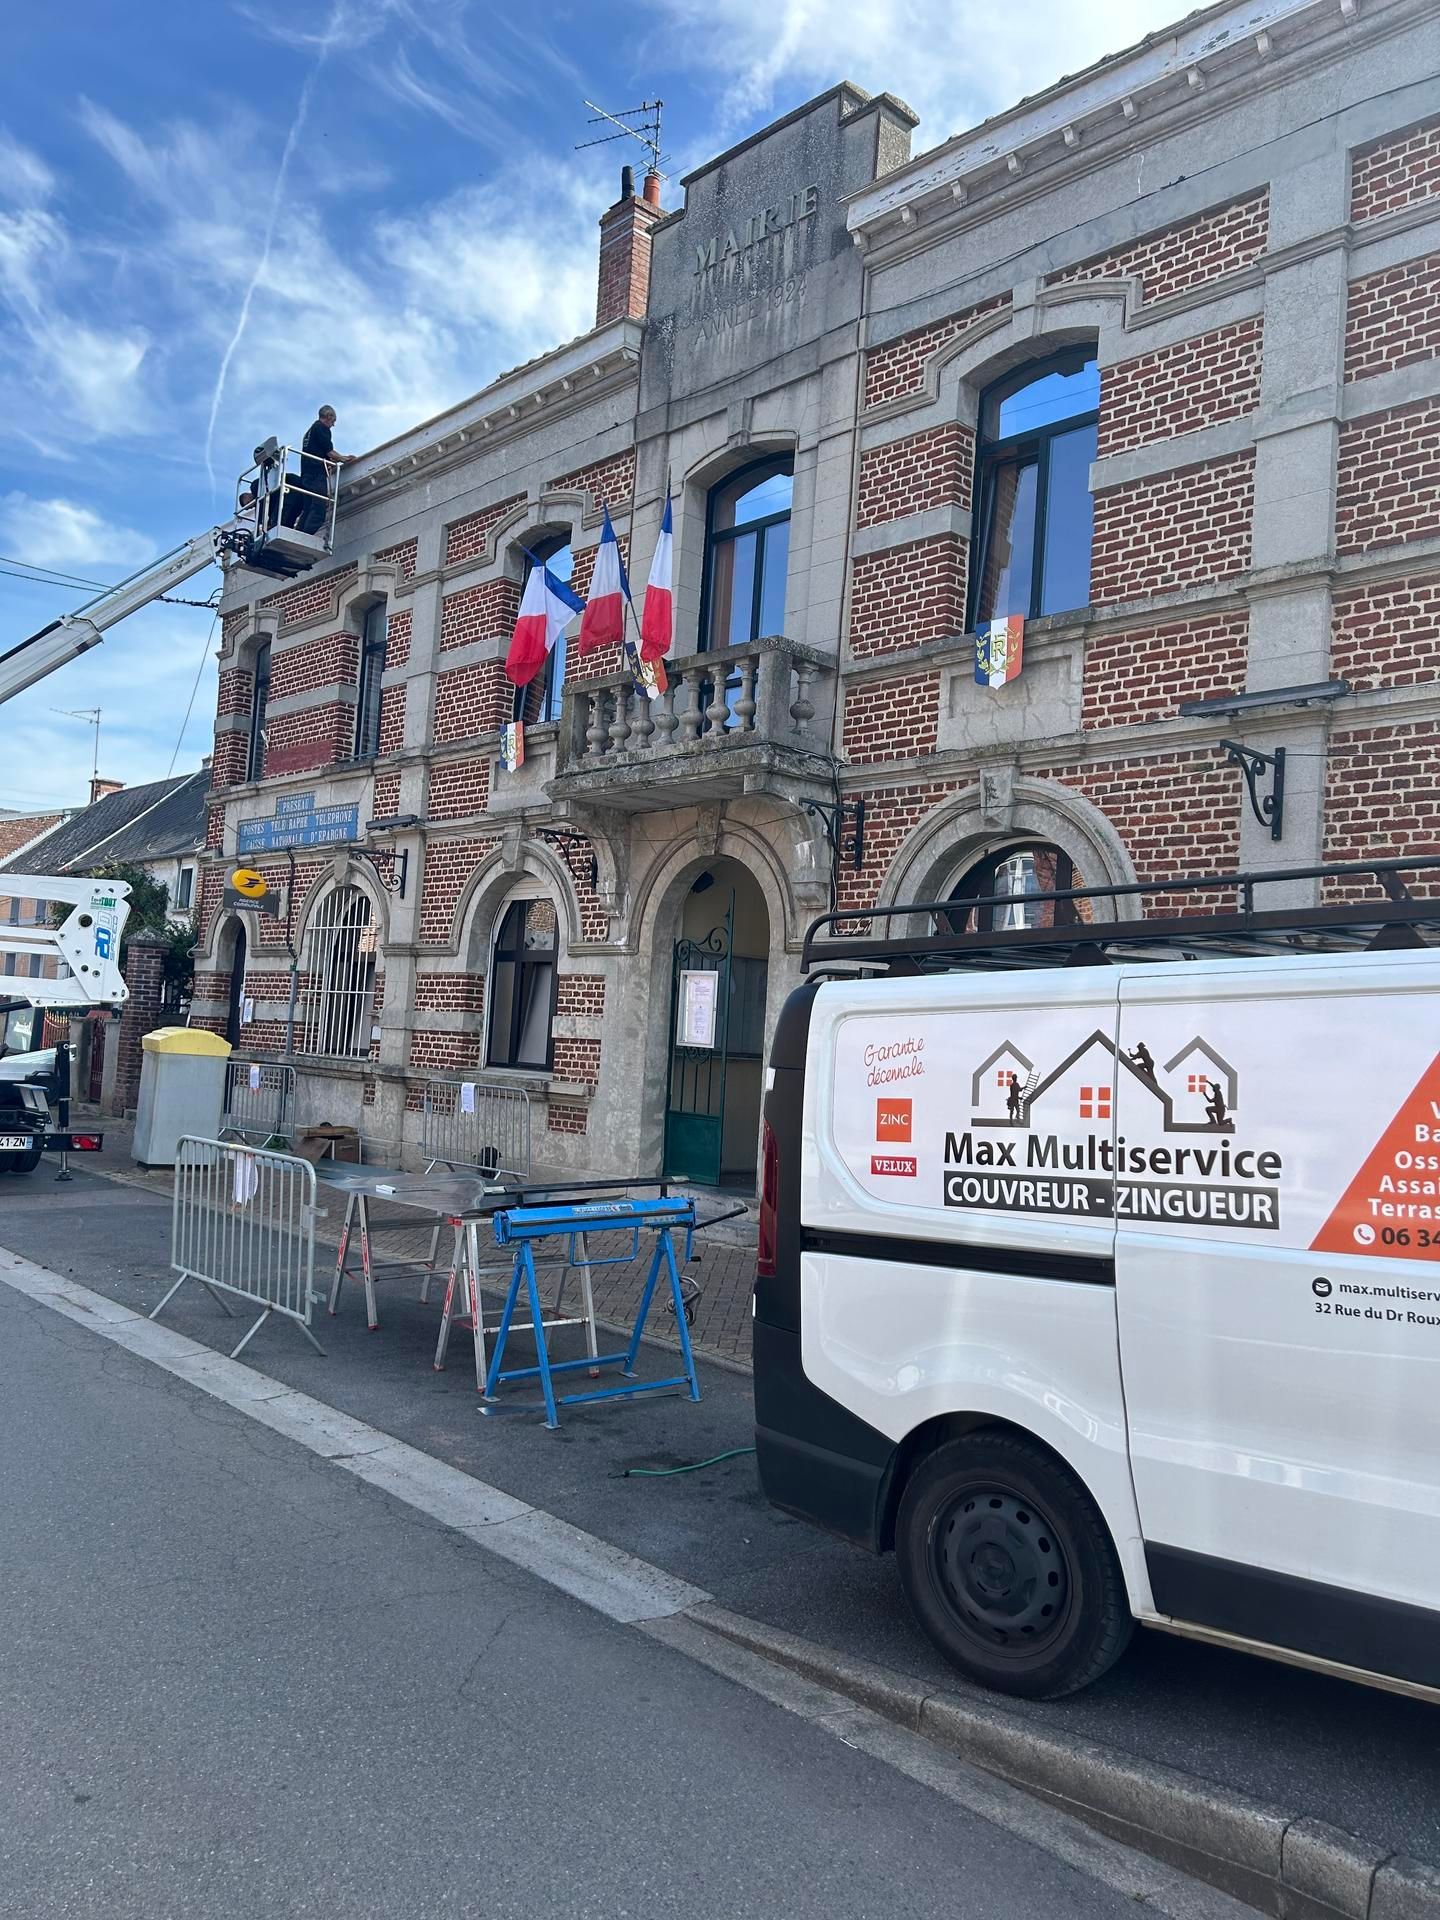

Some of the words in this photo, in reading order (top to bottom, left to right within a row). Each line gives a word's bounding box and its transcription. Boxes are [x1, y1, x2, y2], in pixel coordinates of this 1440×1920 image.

[694, 183, 818, 276] MAIRIE
[243, 822, 265, 836] POSTES
[315, 810, 353, 825] TELEPHONE
[272, 832, 303, 847] NATIONALE
[864, 1037, 924, 1066] Garantie
[880, 1113, 909, 1125] ZINC
[1415, 1124, 1440, 1142] Ba
[944, 1132, 1017, 1167] Max
[1027, 1134, 1282, 1179] Multiservice
[1394, 1151, 1439, 1170] Oss
[947, 1176, 1090, 1210] COUVREUR
[1112, 1186, 1274, 1222] ZINGUEUR
[1368, 1198, 1440, 1219] Terras
[1381, 1227, 1411, 1246] 06
[1417, 1229, 1440, 1247] 34
[1339, 1284, 1440, 1302] max.multiserv
[1315, 1302, 1332, 1314] 32
[1335, 1304, 1361, 1317] Rue
[1364, 1307, 1383, 1319] du
[1386, 1309, 1404, 1322] Dr
[1407, 1311, 1440, 1326] Roux
